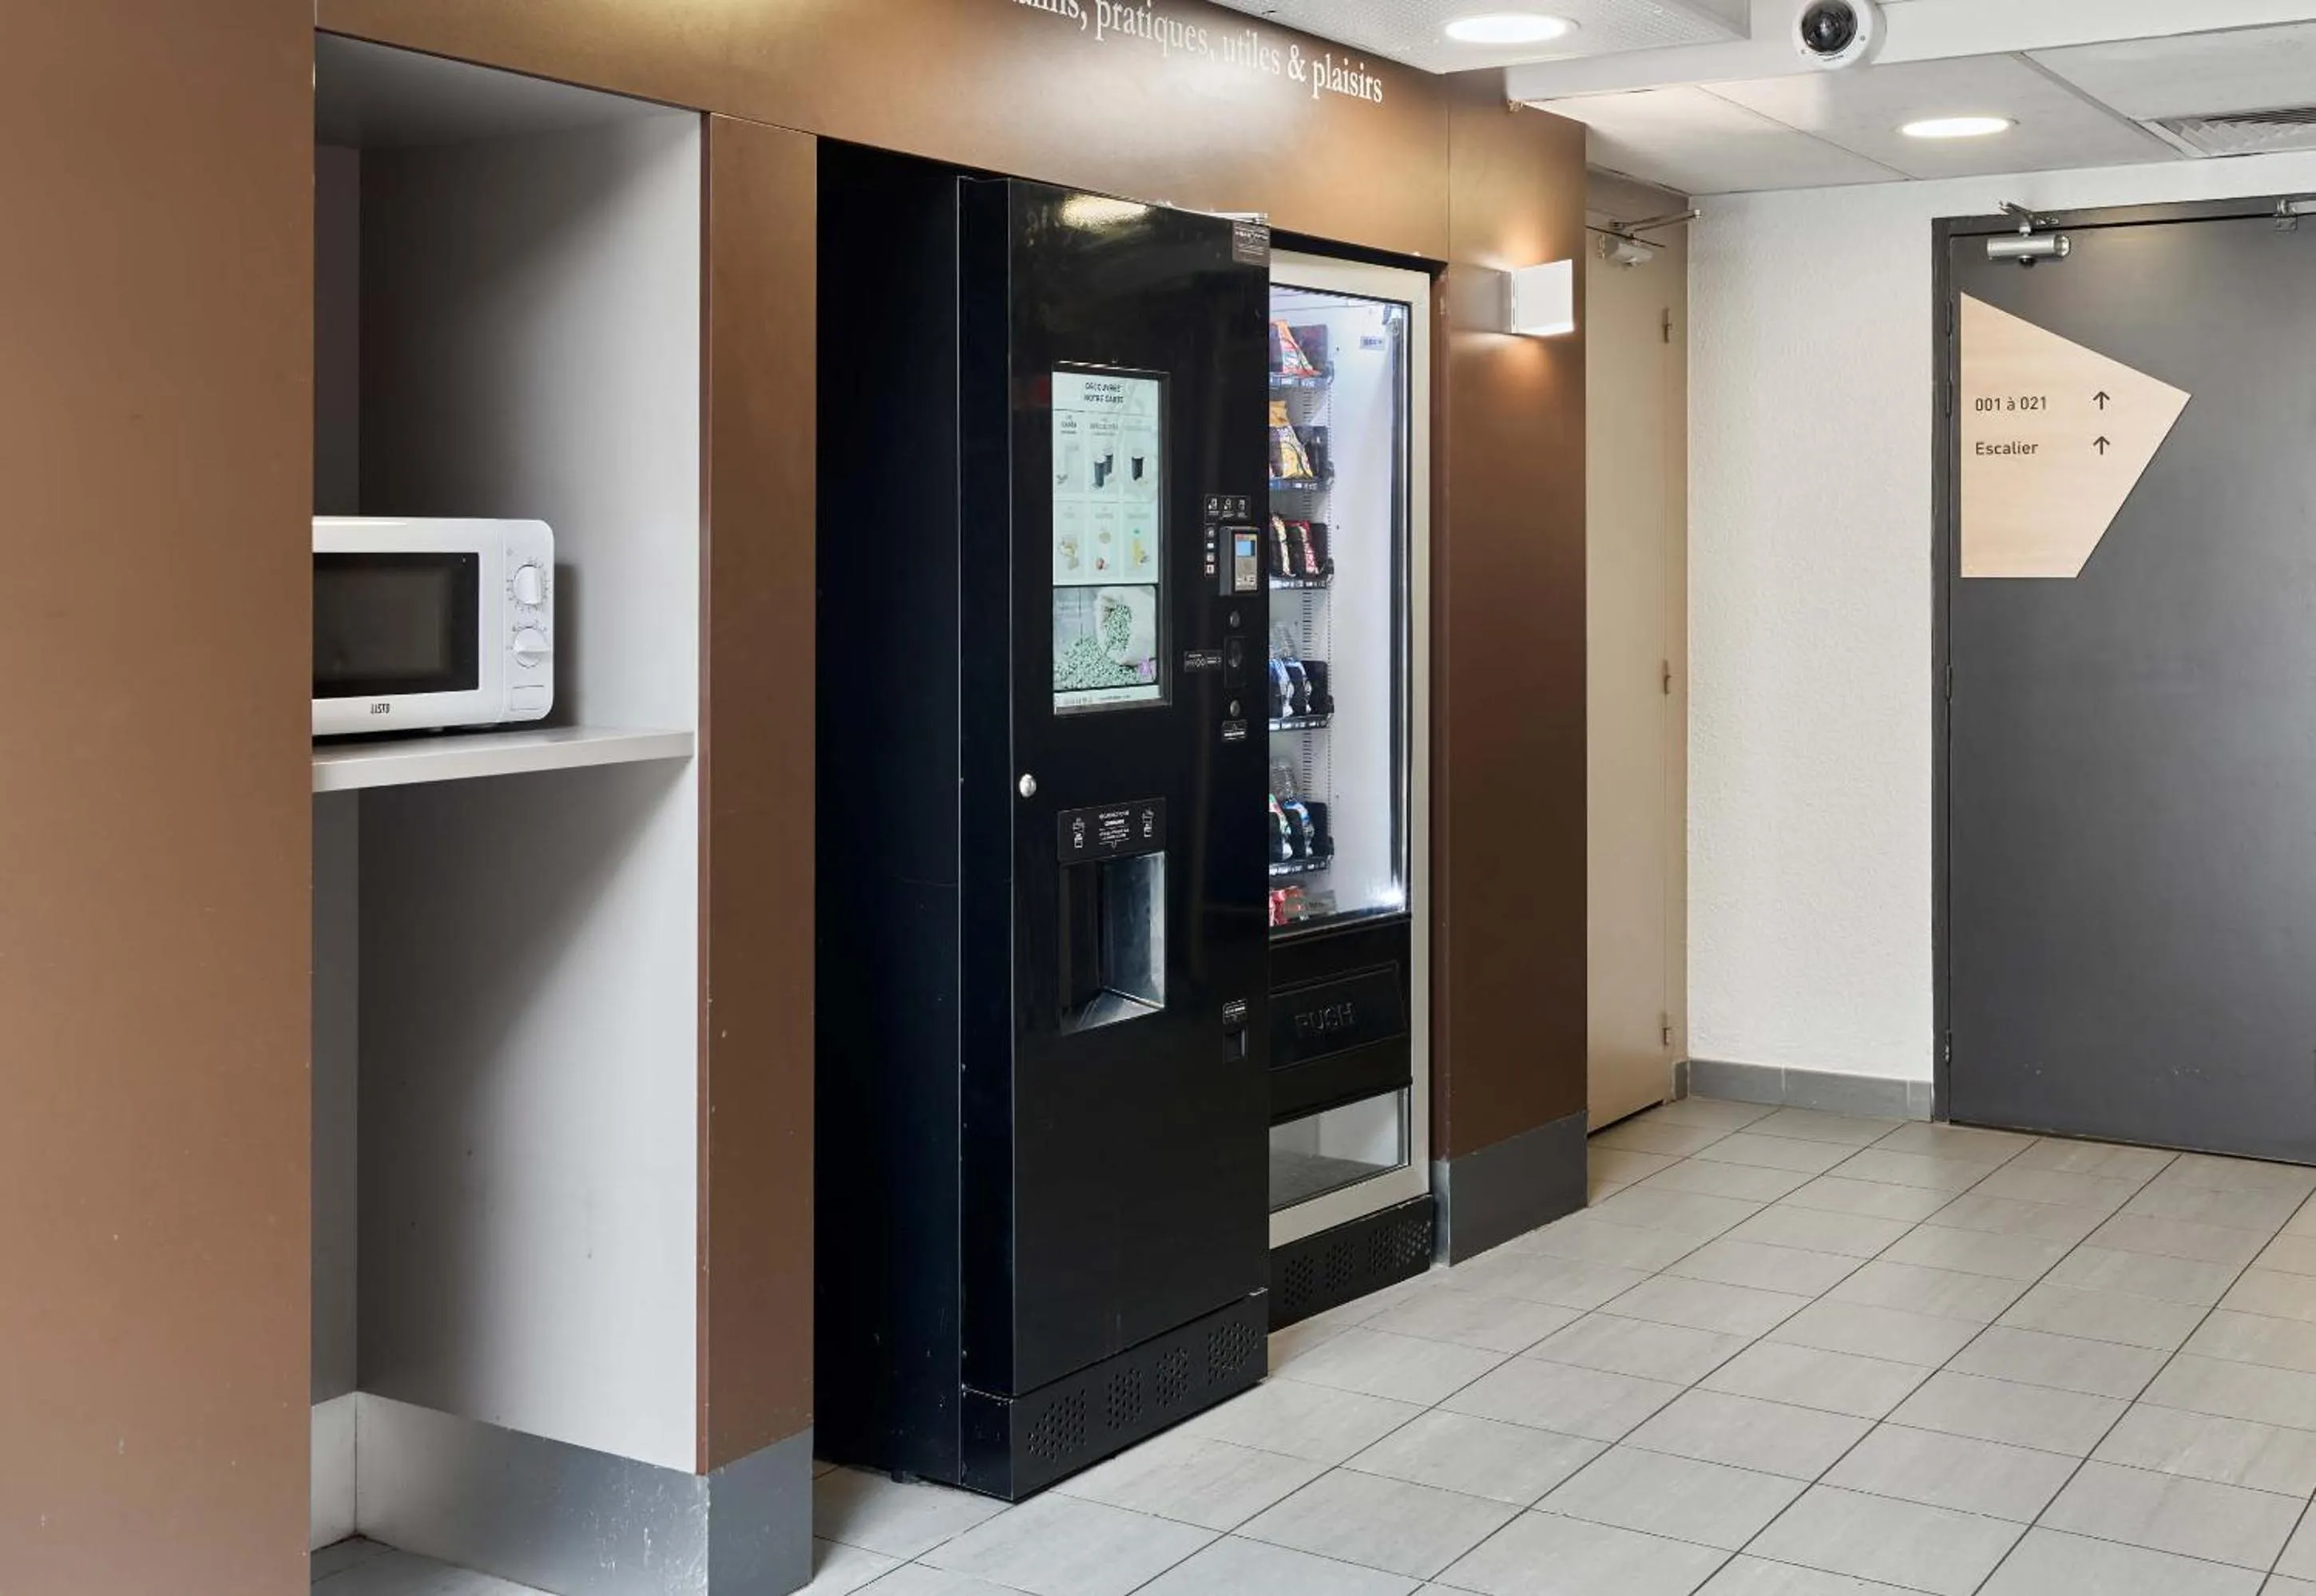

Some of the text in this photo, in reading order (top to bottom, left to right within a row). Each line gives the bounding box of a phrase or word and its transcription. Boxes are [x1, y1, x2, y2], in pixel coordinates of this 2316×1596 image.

[1095, 0, 1215, 62] pratiques,
[1223, 30, 1279, 75] utiles
[1287, 44, 1307, 82] &
[1312, 53, 1382, 102] plaisirs
[1975, 396, 2047, 411] 001 à 021
[1975, 441, 2039, 456] Escalier
